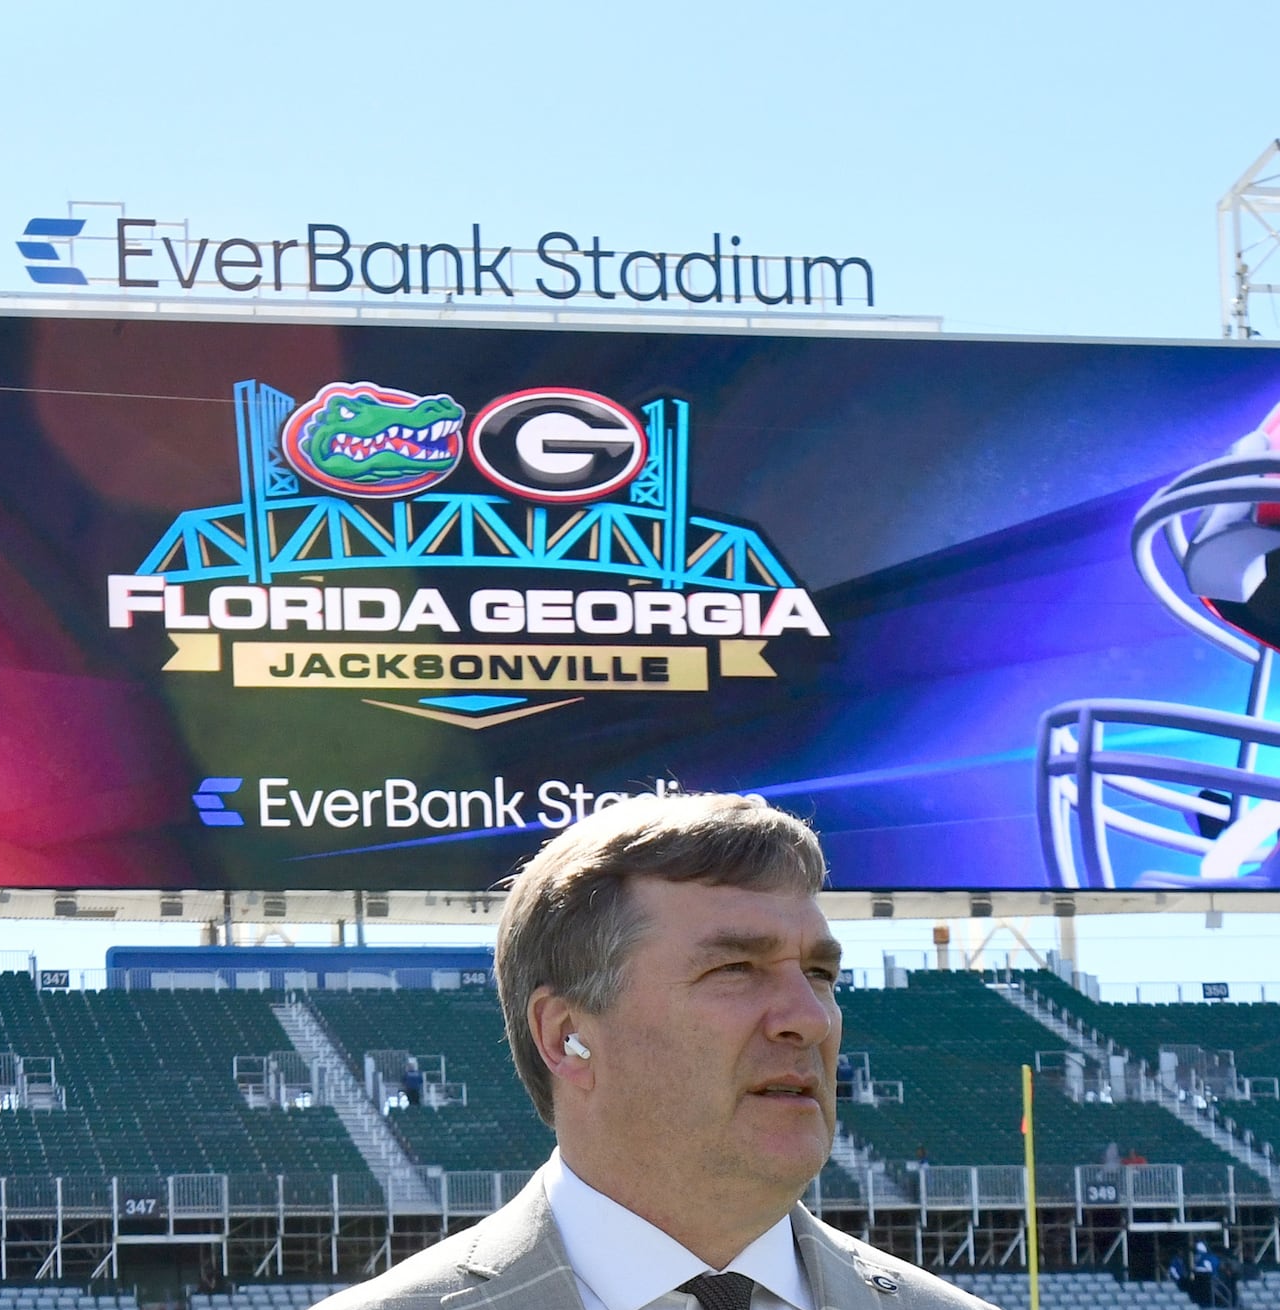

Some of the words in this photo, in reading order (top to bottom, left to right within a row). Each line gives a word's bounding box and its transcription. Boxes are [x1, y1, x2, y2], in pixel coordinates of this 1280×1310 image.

[117, 217, 514, 297] EverBank
[533, 230, 876, 308] Stadium
[107, 574, 461, 634] FLORIDA
[469, 587, 830, 637] GEORGIA
[267, 653, 670, 683] JACKSONVILLE
[259, 776, 526, 829] EverBank
[41, 971, 69, 987] 347
[462, 972, 486, 985] 348
[1203, 984, 1229, 998] 350
[1089, 1184, 1117, 1201] 349
[125, 1199, 157, 1216] 347
